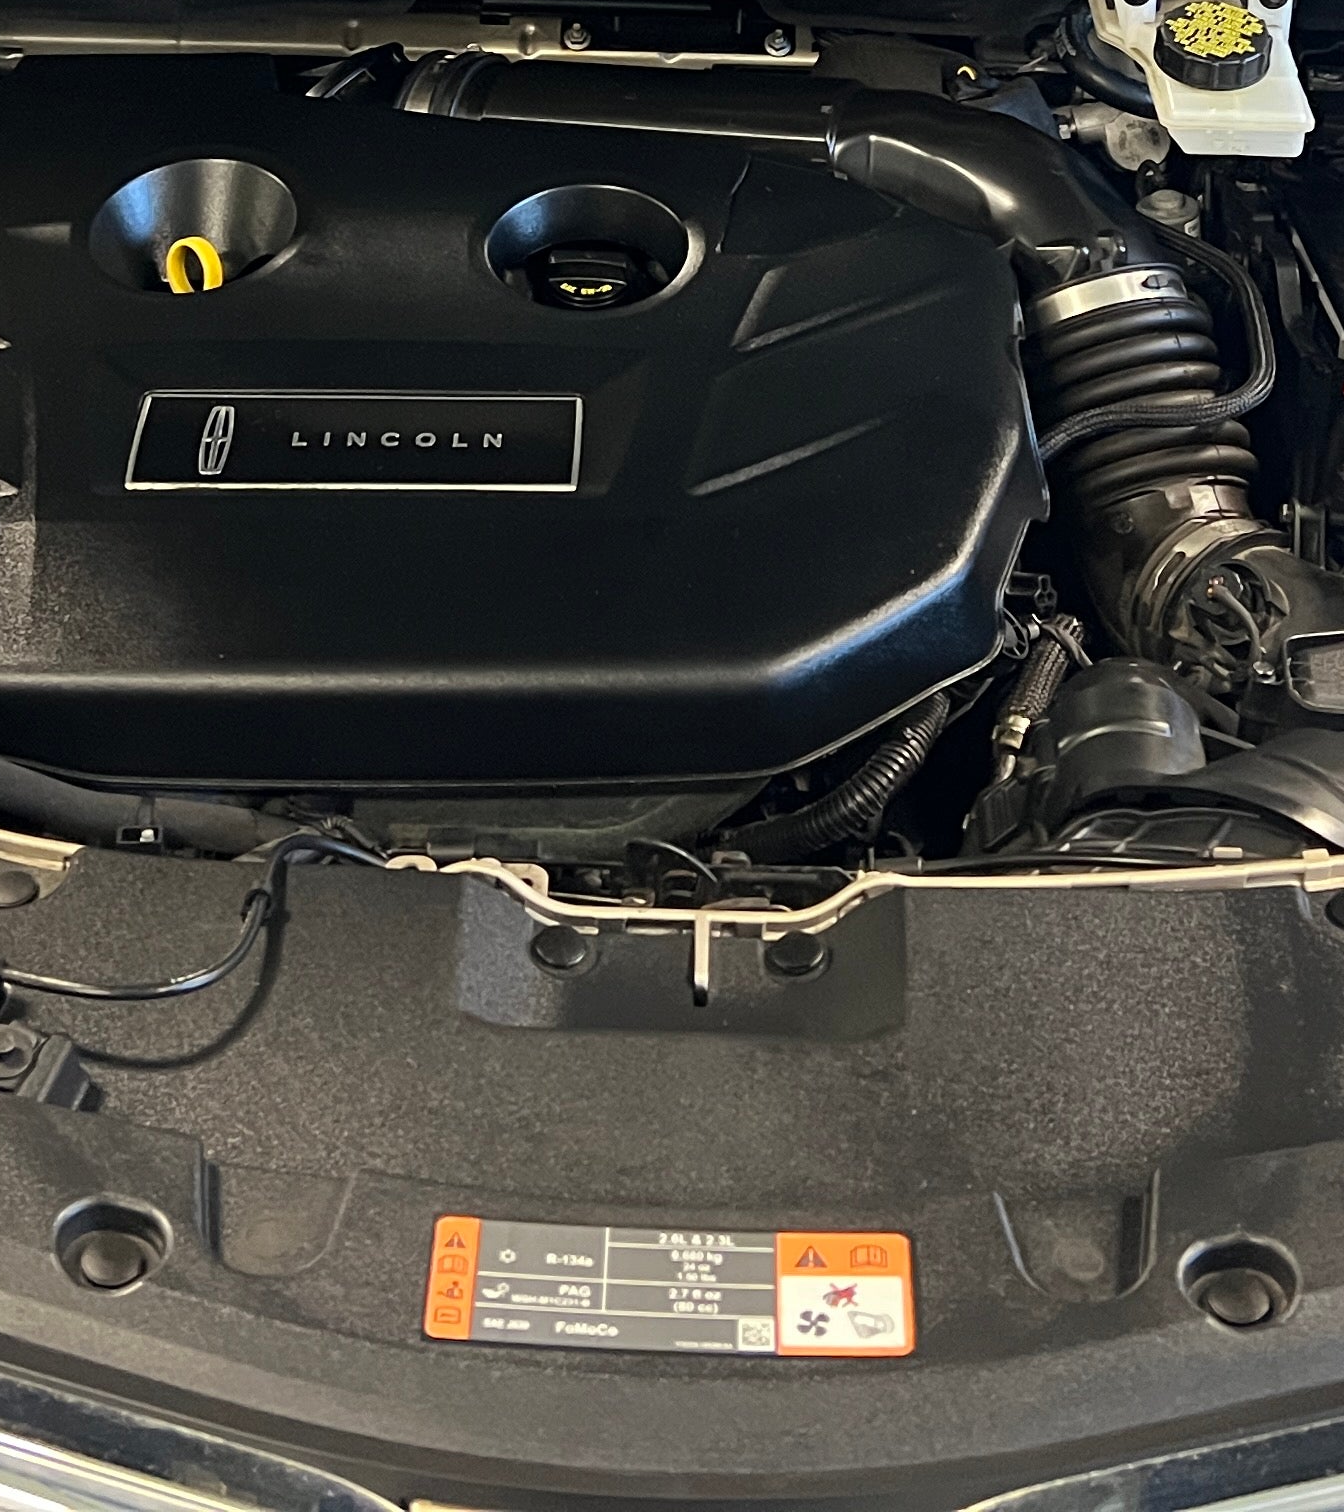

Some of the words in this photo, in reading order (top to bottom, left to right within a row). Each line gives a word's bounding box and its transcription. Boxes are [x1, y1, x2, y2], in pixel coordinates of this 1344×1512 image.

[291, 431, 503, 448] LINCOLN
[691, 1234, 702, 1246] &
[546, 1252, 594, 1267] R-134a
[706, 1252, 723, 1265] kg
[558, 1284, 592, 1298] PAG
[704, 1290, 722, 1301] oz
[554, 1320, 619, 1337] FoMoCo
